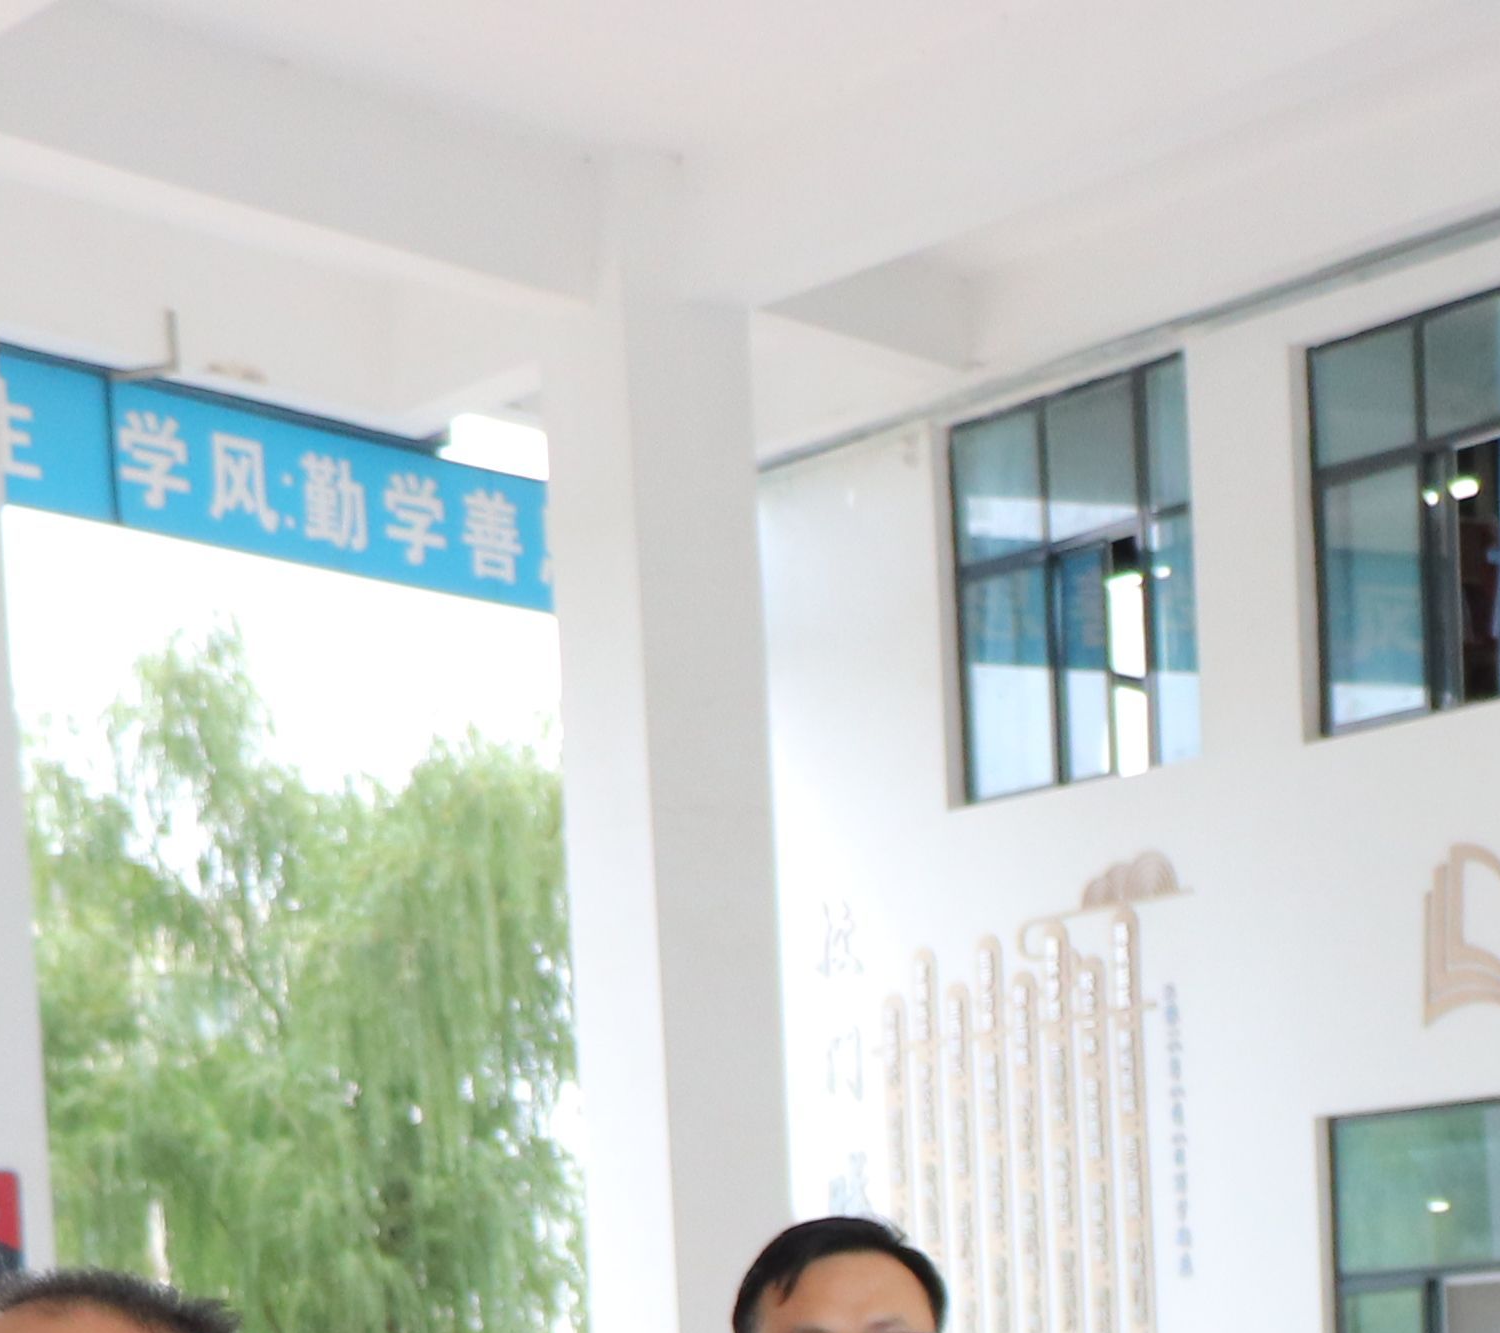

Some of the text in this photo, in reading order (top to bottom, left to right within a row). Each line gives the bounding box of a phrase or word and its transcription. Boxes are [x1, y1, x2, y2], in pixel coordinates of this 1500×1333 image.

[119, 410, 552, 585] 学风:勤学善
